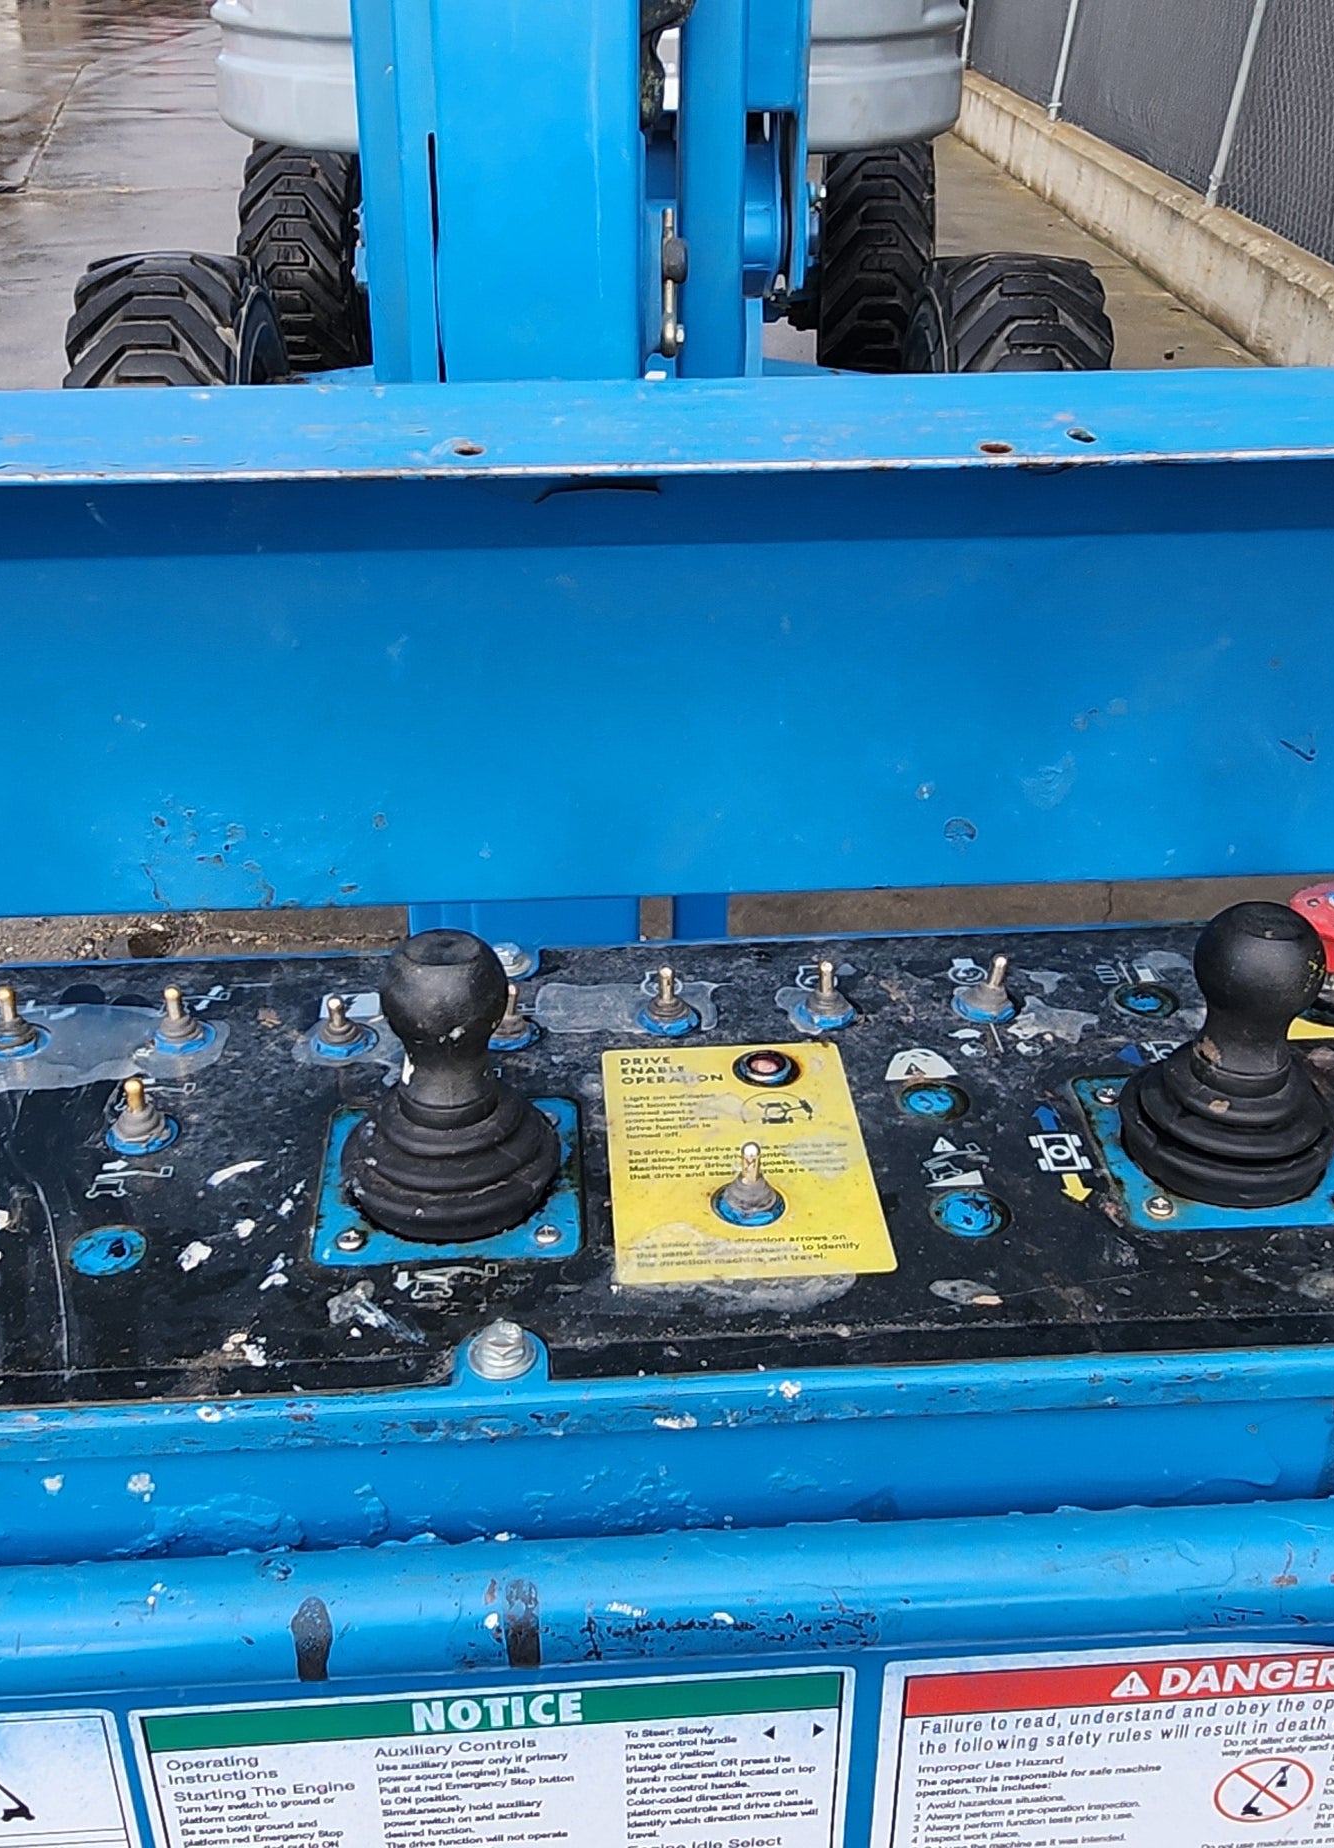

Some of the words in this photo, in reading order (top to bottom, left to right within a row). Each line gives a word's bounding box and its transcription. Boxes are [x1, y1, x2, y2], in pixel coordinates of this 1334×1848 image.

[620, 1056, 670, 1065] DRIVE
[621, 1066, 685, 1075] ENABLE
[412, 1691, 583, 1732] NOTICE
[921, 1719, 982, 1735] Failure
[991, 1716, 1007, 1730] to
[1015, 1713, 1061, 1729] read,
[1070, 1705, 1176, 1725] understand
[1183, 1703, 1217, 1718] and
[1225, 1701, 1270, 1717] obey
[1277, 1698, 1305, 1712] the
[625, 1730, 638, 1738] To
[642, 1729, 673, 1737] Steer:
[678, 1726, 714, 1736] Slowly
[920, 1740, 946, 1755] the
[955, 1735, 1038, 1753] following
[1046, 1731, 1101, 1747] safety
[1108, 1728, 1152, 1743] rules
[1161, 1724, 1189, 1739] will
[1195, 1721, 1246, 1737] result
[1252, 1720, 1267, 1734] in
[1276, 1716, 1326, 1732] death
[375, 1745, 452, 1757] Auxiliary
[459, 1738, 536, 1752] Controls
[658, 1738, 697, 1748] control
[701, 1736, 737, 1745] handle
[167, 1755, 259, 1771] Operating
[401, 1761, 448, 1770] auxiliary
[451, 1759, 485, 1768] power
[488, 1756, 512, 1765] only
[516, 1754, 522, 1762] if
[526, 1753, 568, 1763] primary
[680, 1750, 715, 1760] yellow
[626, 1764, 666, 1773] triangle
[670, 1761, 717, 1769] direction
[721, 1758, 737, 1766] OR
[741, 1758, 770, 1767] press
[919, 1763, 981, 1774] Improper
[986, 1761, 1011, 1769] Use
[1016, 1756, 1064, 1767] Hazard
[168, 1769, 279, 1785] Instructions
[378, 1775, 411, 1785] power
[456, 1768, 500, 1779] (engine)
[504, 1767, 529, 1775] fails.
[627, 1775, 660, 1784] thumb
[664, 1773, 698, 1782] rocker
[701, 1770, 735, 1779] switch
[740, 1767, 778, 1776] located
[917, 1779, 937, 1787] The
[940, 1777, 987, 1786] operator
[1004, 1770, 1067, 1781] responsible
[1071, 1769, 1086, 1777] for
[1089, 1767, 1112, 1775] safe
[1115, 1765, 1161, 1774] machine
[174, 1789, 246, 1802] Starting
[251, 1787, 286, 1796] The
[293, 1782, 355, 1795] Engine
[379, 1786, 400, 1794] Pull
[403, 1785, 421, 1793] out
[425, 1783, 442, 1791] red
[445, 1780, 507, 1790] Emergency
[511, 1778, 536, 1786] Stop
[627, 1787, 637, 1795] of
[670, 1783, 708, 1792] control
[711, 1781, 750, 1789] handle.
[915, 1788, 971, 1798] operation.
[975, 1785, 997, 1793] This
[1002, 1783, 1051, 1791] includes:
[204, 1805, 224, 1813] key
[228, 1801, 263, 1810] switch
[281, 1797, 320, 1808] ground
[395, 1796, 411, 1804] ON
[415, 1794, 462, 1805] position.
[627, 1795, 692, 1806] Color-coded
[696, 1793, 742, 1802] direction
[382, 1805, 466, 1816] Simultaneously
[469, 1802, 492, 1811] hold
[496, 1800, 542, 1809] auxiliary
[627, 1809, 671, 1819] platform
[674, 1805, 717, 1814] controls
[722, 1803, 741, 1811] and
[774, 1798, 813, 1807] chassis
[179, 1816, 225, 1826] platform
[228, 1812, 270, 1821] control.
[255, 1821, 294, 1832] ground
[298, 1820, 317, 1828] and
[384, 1820, 416, 1829] power
[420, 1817, 454, 1825] switch
[475, 1813, 494, 1821] and
[498, 1811, 540, 1819] activate
[627, 1819, 666, 1828] identify
[669, 1817, 700, 1825] which
[704, 1814, 750, 1823] direction
[754, 1811, 797, 1819] machine
[801, 1808, 818, 1816] will
[184, 1839, 229, 1848] platform
[233, 1836, 250, 1844] red
[253, 1833, 315, 1842] Emergency
[318, 1830, 343, 1838] Stop
[385, 1829, 424, 1838] desired
[428, 1827, 475, 1835] function.
[528, 1832, 567, 1840] operate
[729, 1836, 782, 1848] Select
